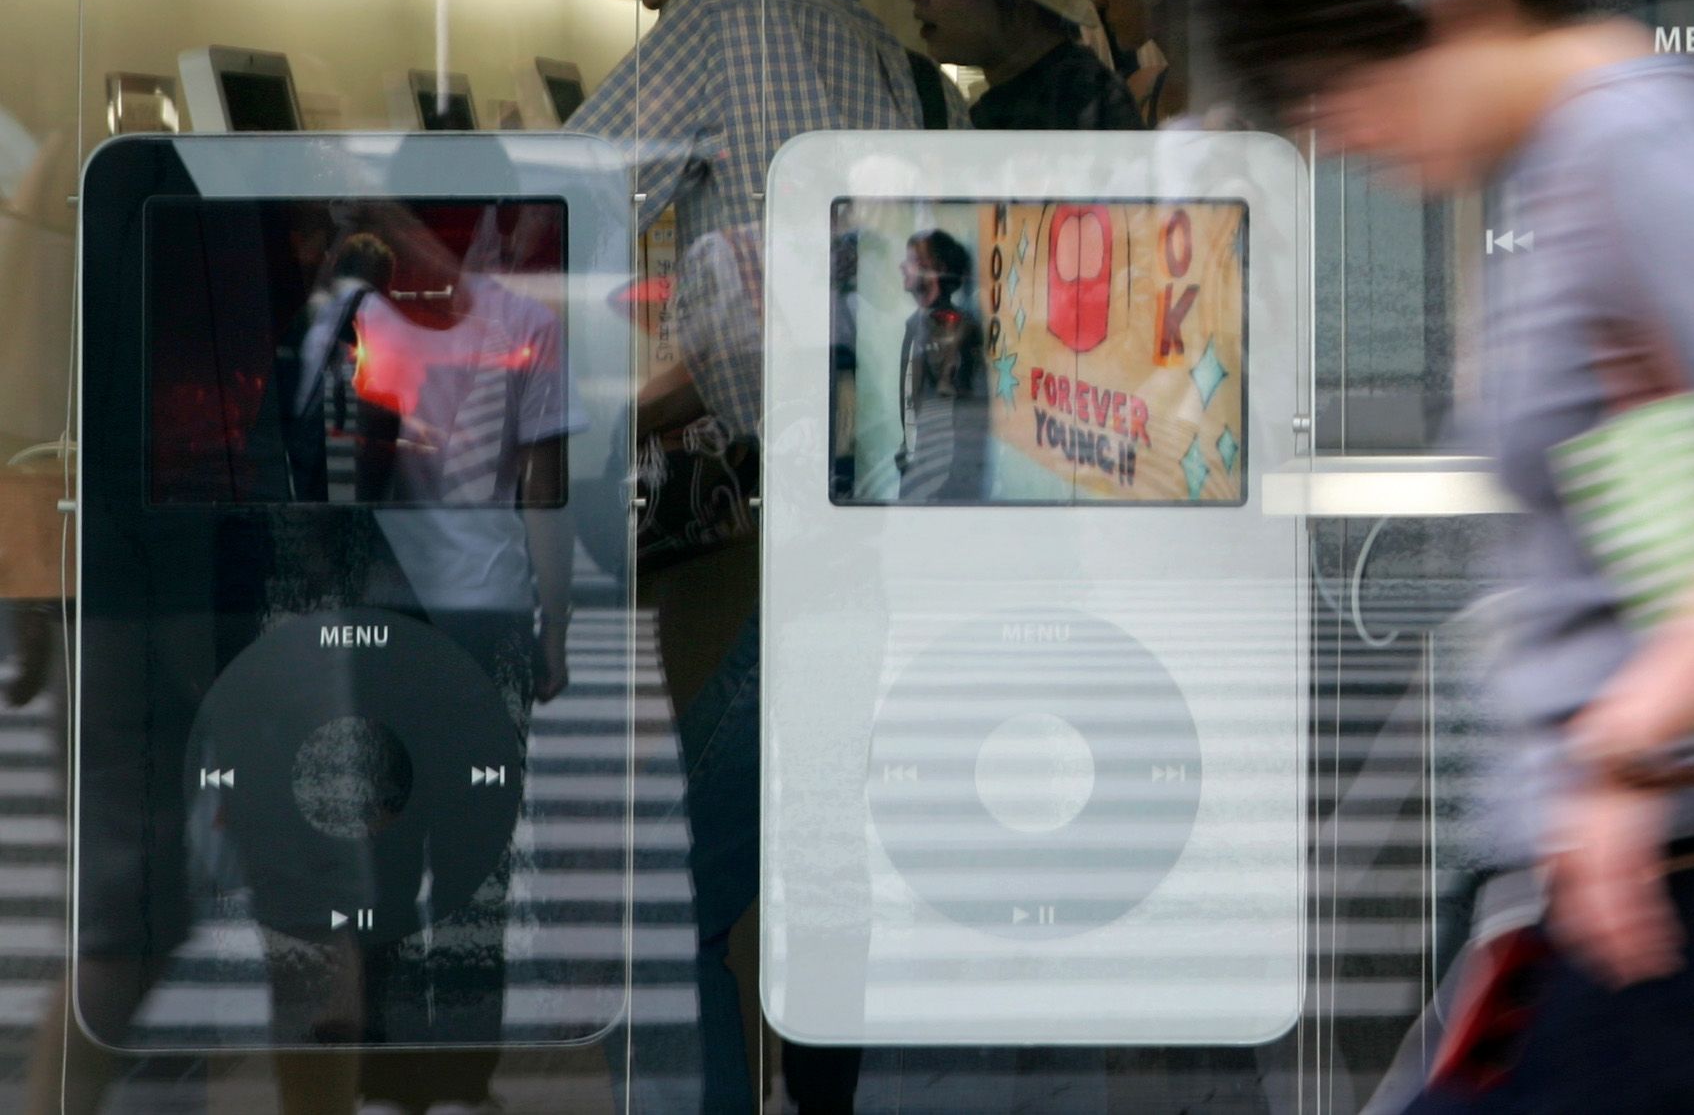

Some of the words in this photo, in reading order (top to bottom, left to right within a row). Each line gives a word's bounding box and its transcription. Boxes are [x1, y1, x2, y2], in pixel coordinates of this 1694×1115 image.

[1030, 367, 1152, 449] FOREVER
[319, 626, 389, 648] MENU
[1002, 623, 1071, 645] MENU
